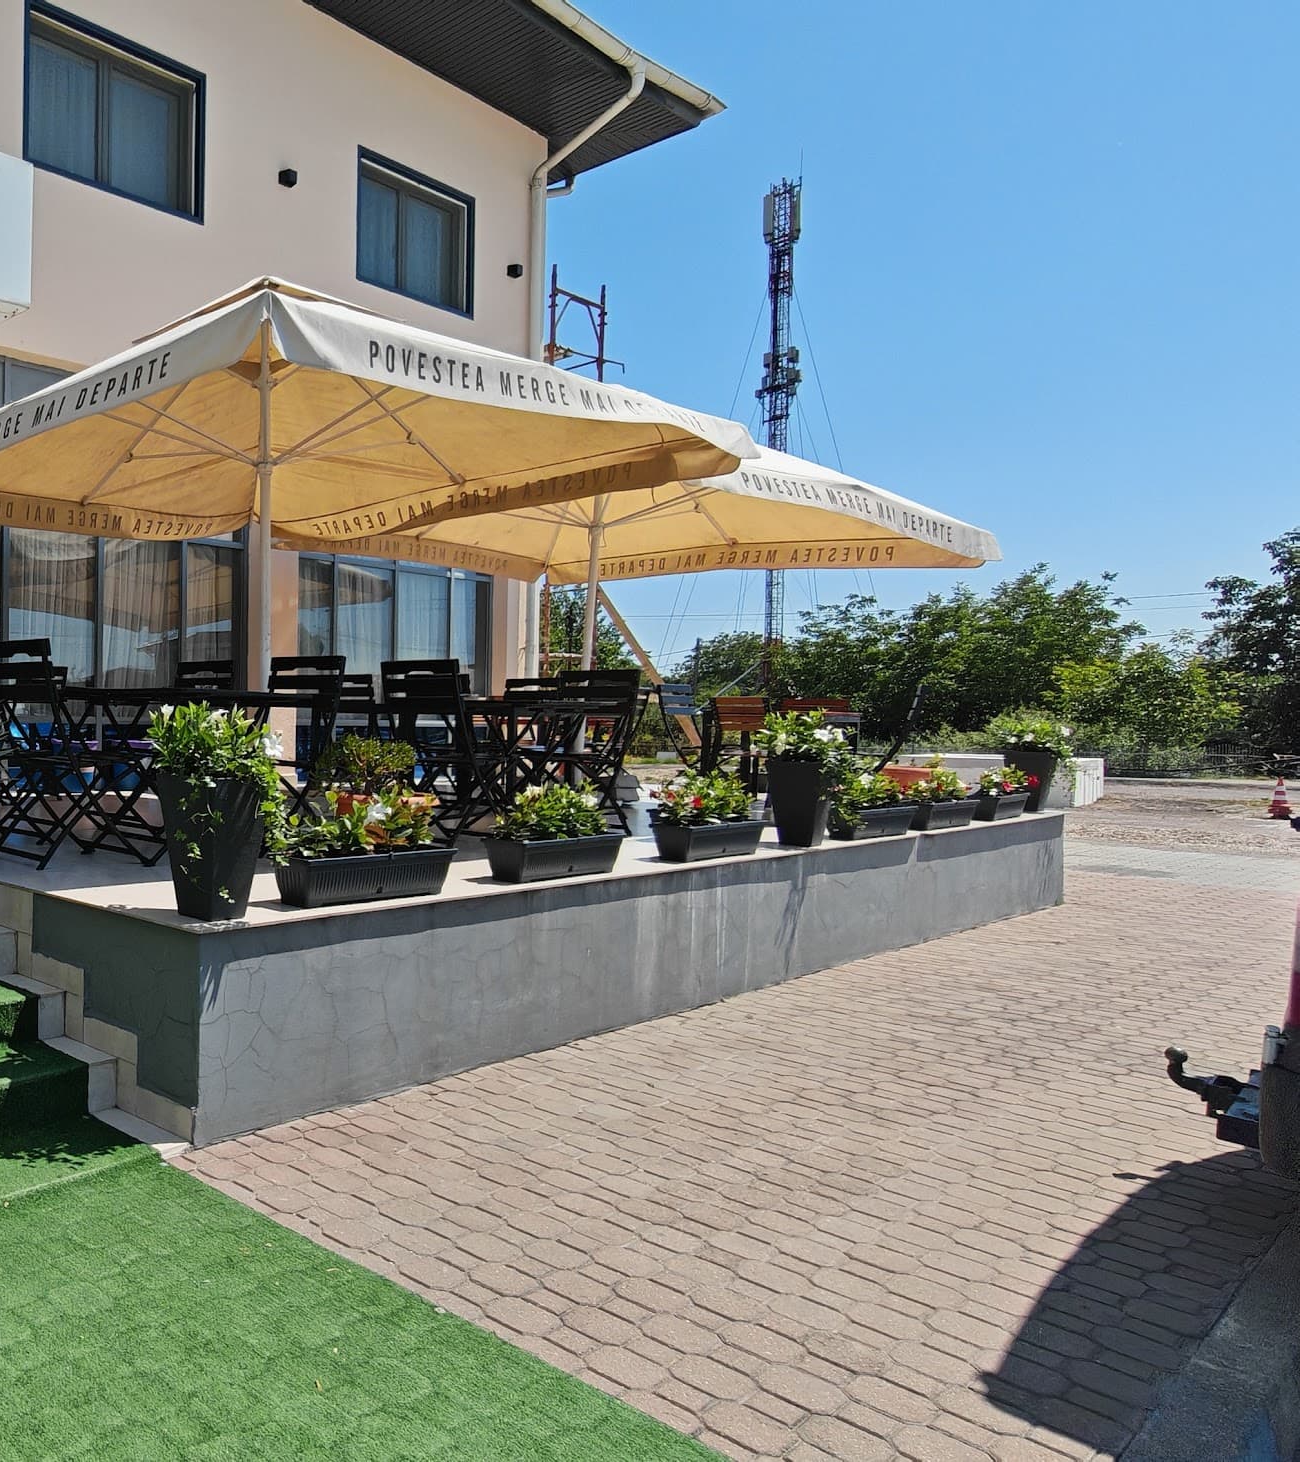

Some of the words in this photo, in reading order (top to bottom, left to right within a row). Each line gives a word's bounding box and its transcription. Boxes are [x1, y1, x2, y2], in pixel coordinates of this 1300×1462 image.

[31, 396, 67, 428] MAI
[75, 351, 171, 411] DEPARTE
[369, 340, 485, 393] POVESTEA
[499, 371, 570, 406] MERGE
[580, 388, 615, 413] MAI
[741, 471, 822, 502] POVESTEA
[826, 487, 872, 514] MERGE
[876, 501, 897, 525] MAI
[902, 511, 953, 543] DEPARTE
